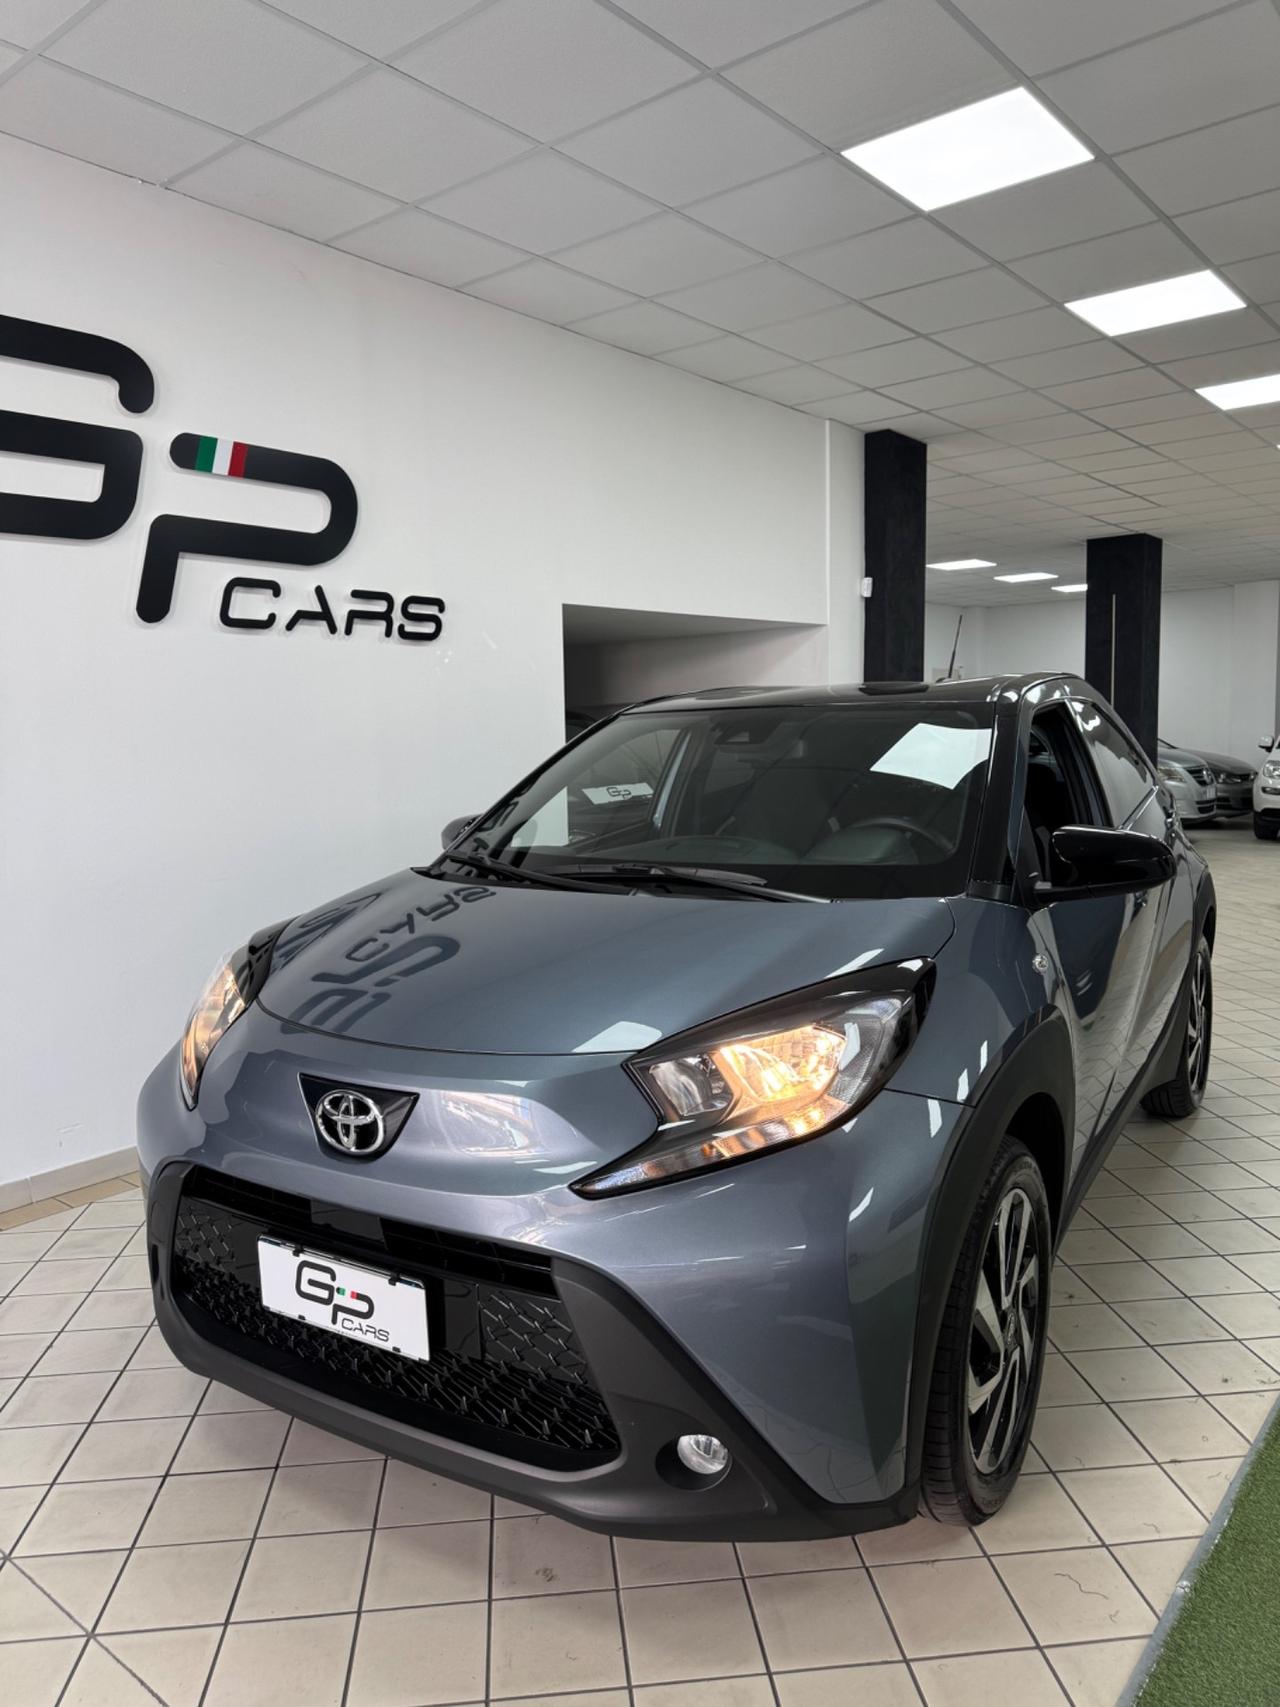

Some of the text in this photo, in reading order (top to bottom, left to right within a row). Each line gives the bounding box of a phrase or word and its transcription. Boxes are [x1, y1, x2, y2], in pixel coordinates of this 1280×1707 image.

[219, 577, 445, 641] CARS
[296, 1261, 374, 1325] GP
[341, 1318, 390, 1342] CARS
